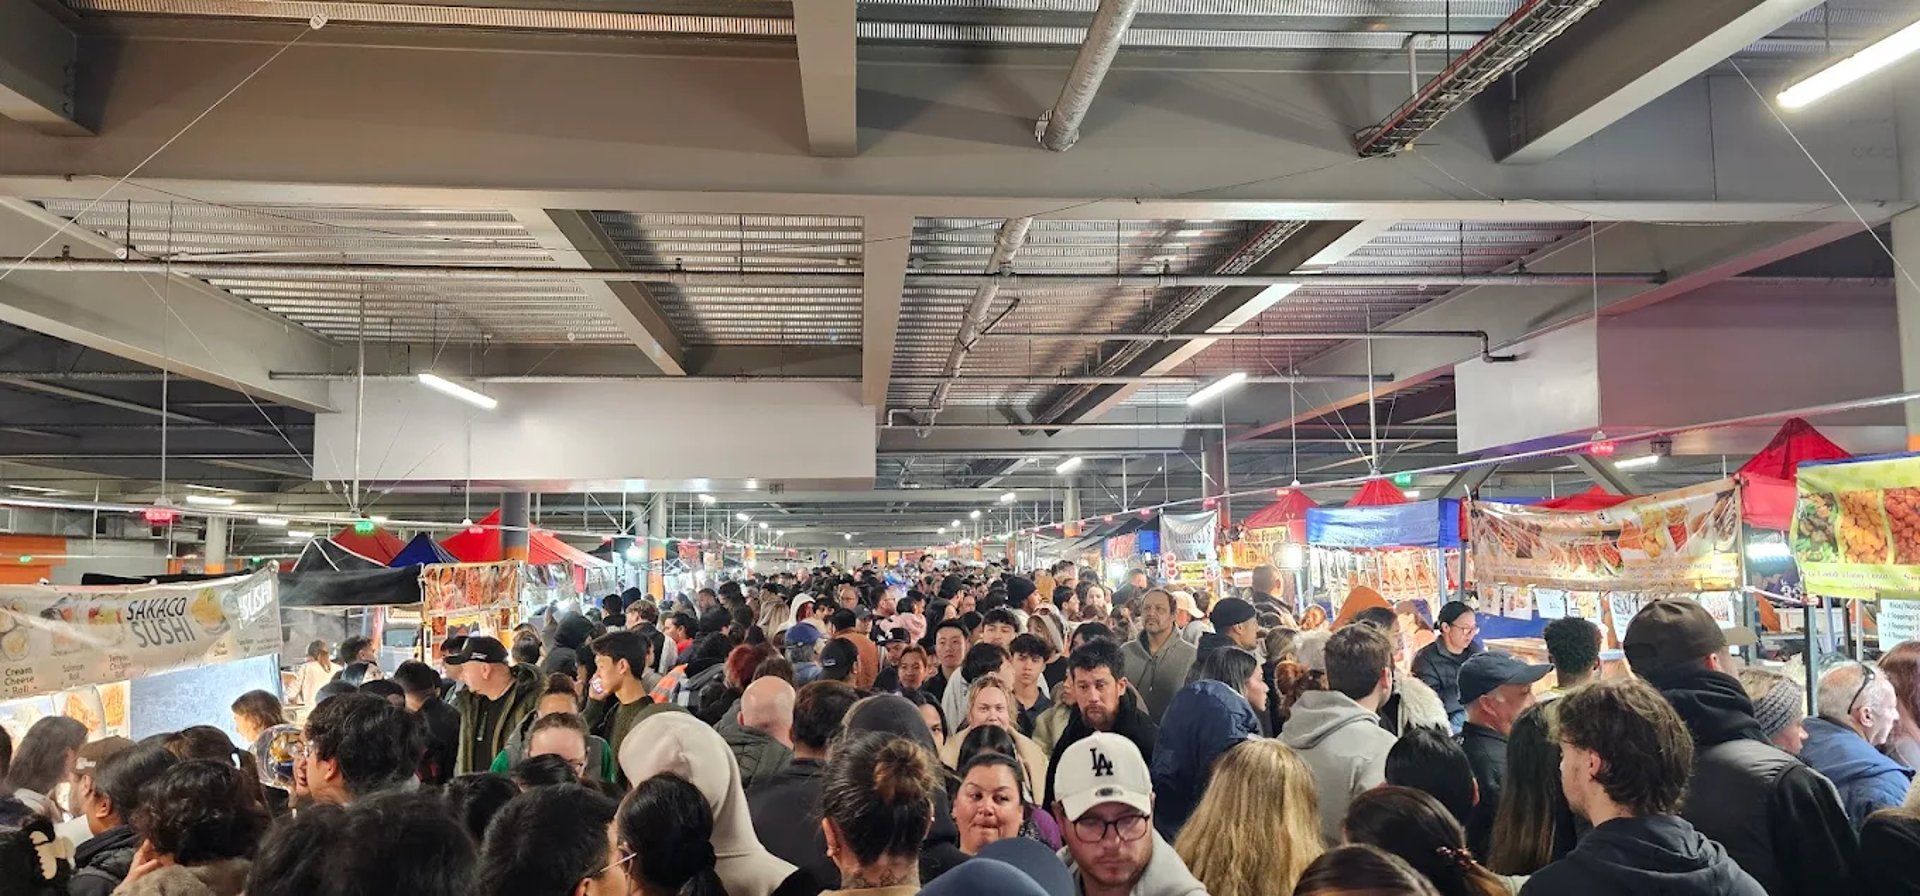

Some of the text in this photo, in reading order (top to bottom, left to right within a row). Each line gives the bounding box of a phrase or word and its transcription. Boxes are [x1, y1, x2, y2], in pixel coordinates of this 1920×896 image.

[126, 597, 187, 621] SAKACO
[130, 617, 196, 648] SUSHI
[5, 667, 33, 676] Cream
[4, 676, 34, 686] Cheese
[12, 686, 29, 694] Roll
[1090, 748, 1114, 776] LA
